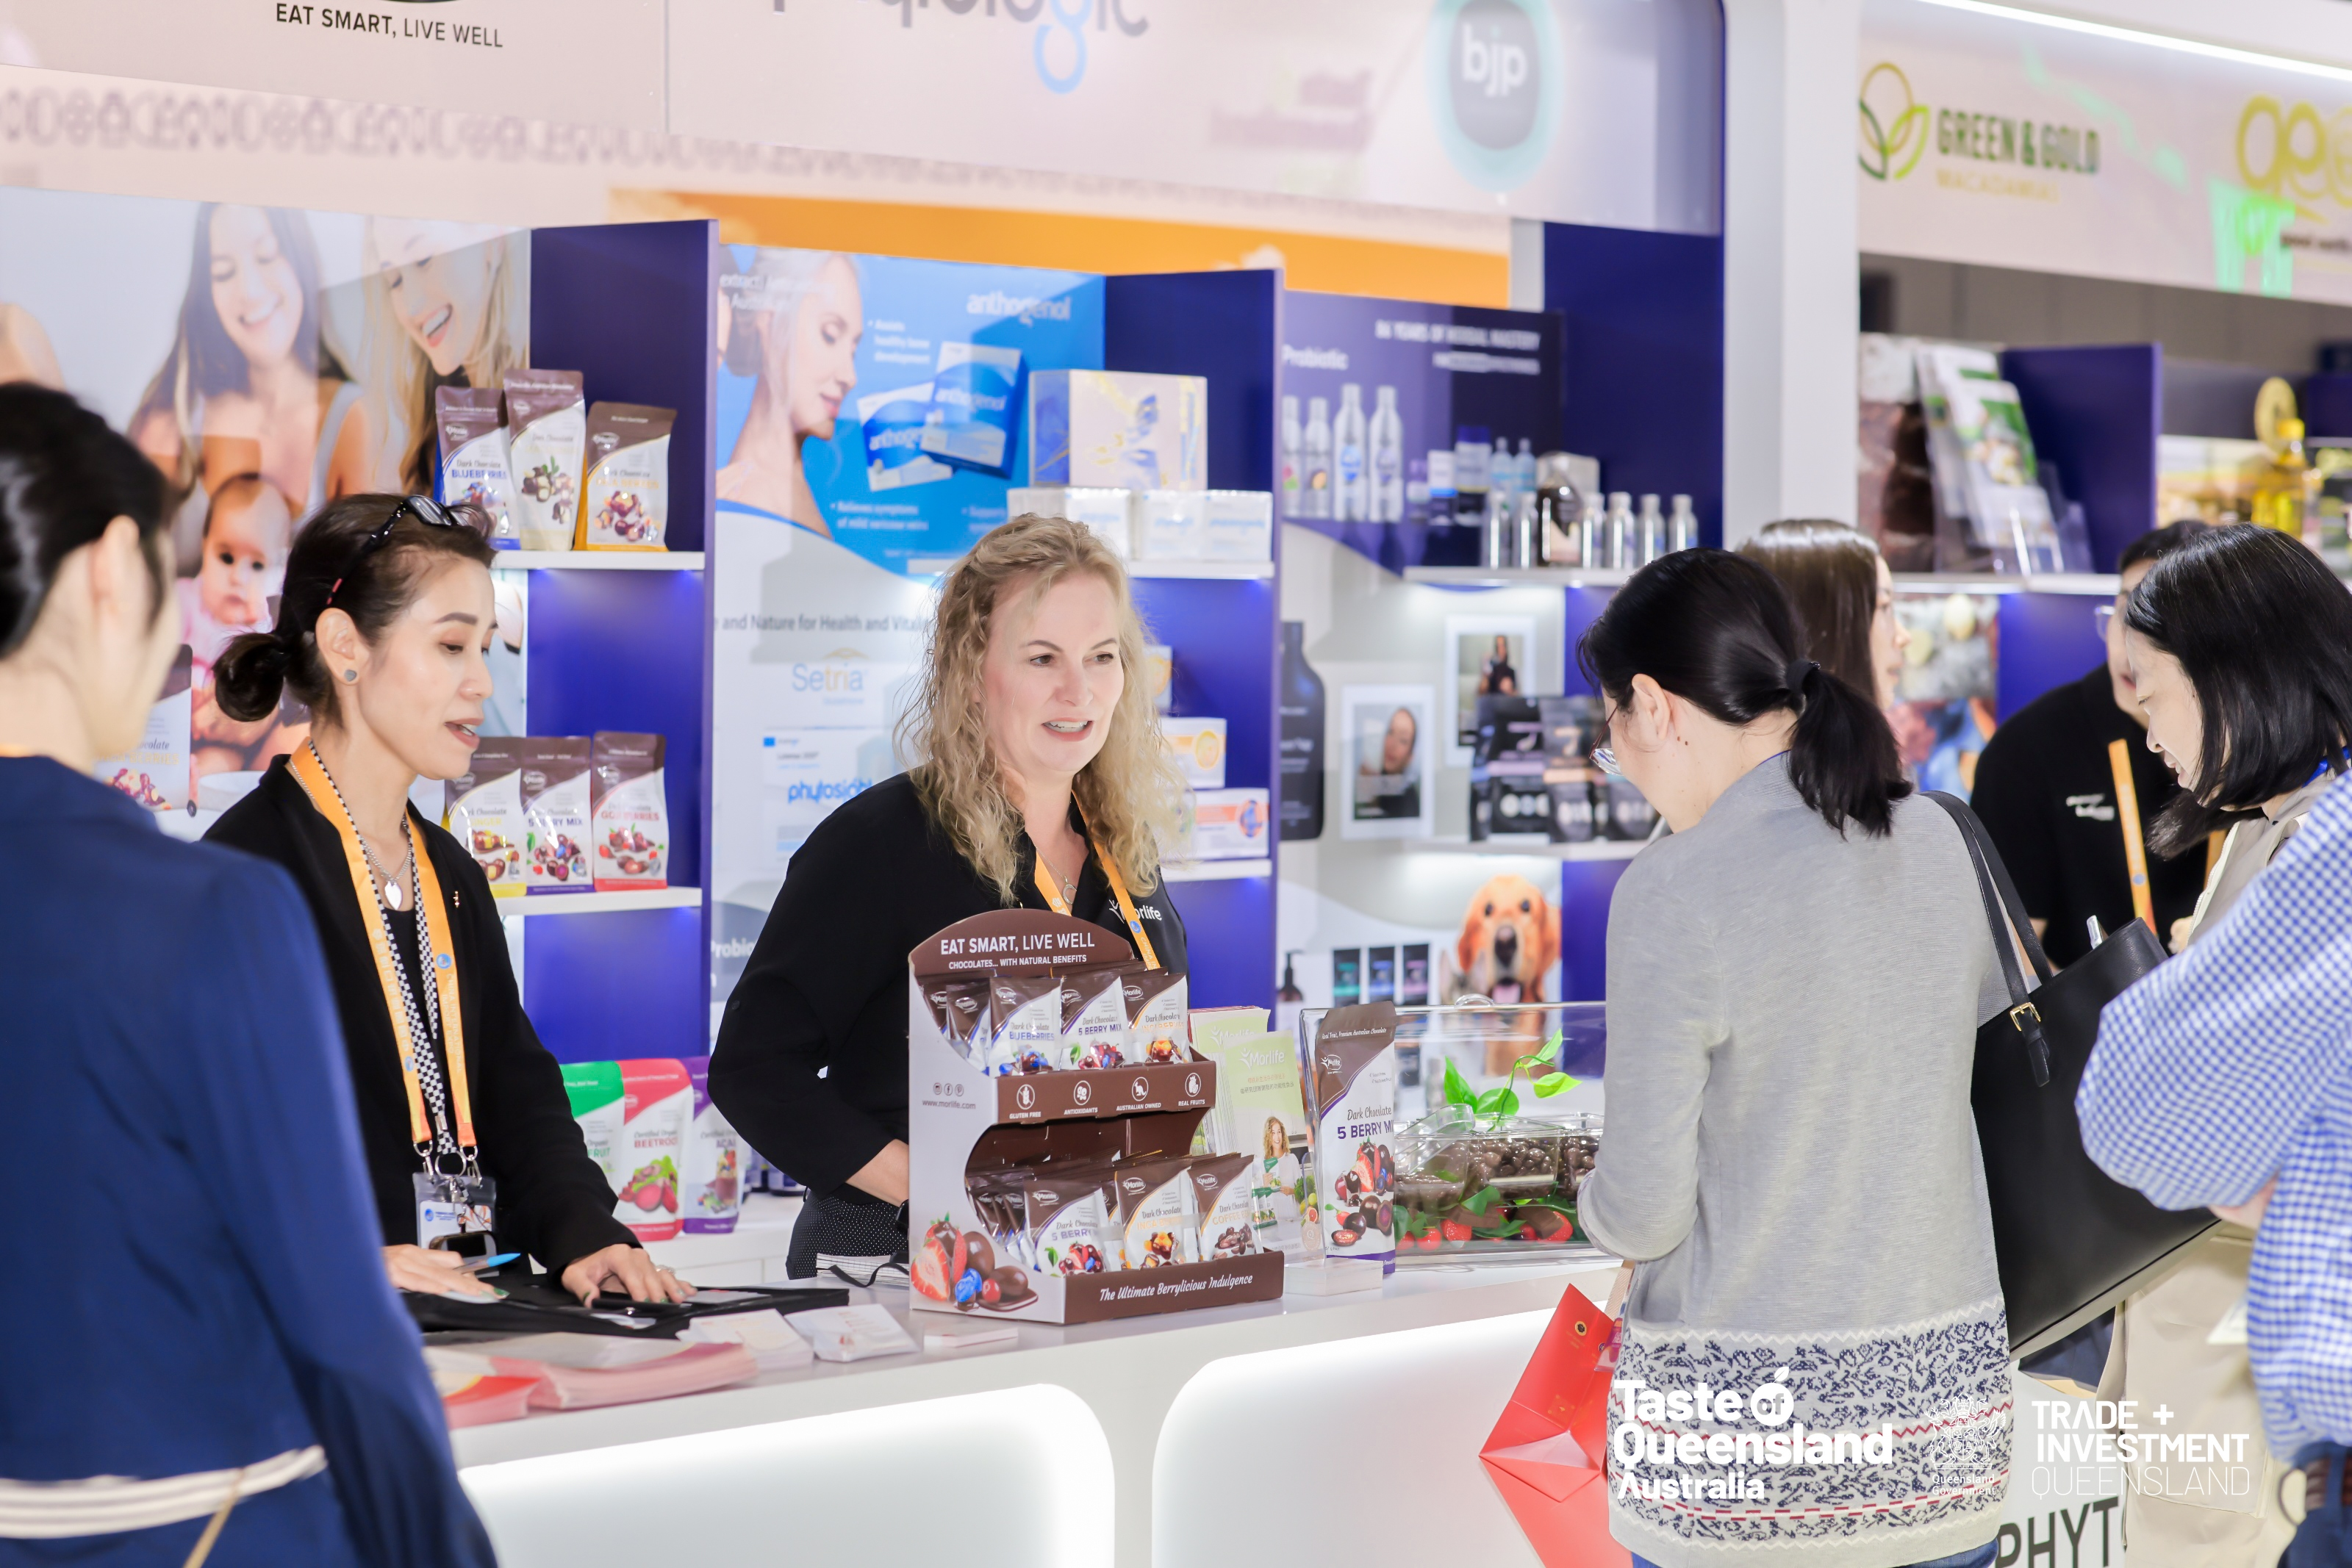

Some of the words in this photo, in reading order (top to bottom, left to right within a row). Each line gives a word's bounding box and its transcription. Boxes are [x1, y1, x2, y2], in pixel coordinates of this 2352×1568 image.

[276, 3, 314, 25] EAT
[321, 8, 397, 38] SMART,
[404, 18, 445, 41] LIVE
[453, 24, 503, 48] WELL
[1461, 22, 1530, 98] bjp
[967, 291, 1072, 324] anthogenol
[721, 616, 747, 631] and
[750, 615, 797, 632] Nature
[799, 614, 817, 632] for
[820, 615, 862, 633] Health
[865, 616, 890, 633] and
[792, 663, 864, 693] Setria
[601, 810, 621, 821] GO
[567, 818, 583, 827] MIX
[941, 939, 965, 955] EAT
[969, 935, 1019, 954] SMART,
[1022, 934, 1053, 950] LIVE
[1057, 932, 1095, 949] WELL
[1140, 937, 1152, 960] CHINA
[948, 959, 999, 970] CHOCOLATES...
[1000, 958, 1018, 967] WITH
[1019, 956, 1052, 965] NATURAL
[1053, 954, 1087, 964] BENEFITS
[446, 974, 455, 1001] CHINA
[1083, 1017, 1094, 1026] Dark
[1144, 1015, 1158, 1023] Dark
[1158, 1012, 1180, 1021] Chocola
[1078, 1027, 1083, 1036] 5
[1085, 1025, 1108, 1035] BERRY
[1109, 1023, 1122, 1032] MIX
[450, 1004, 462, 1073] INTERNATIONAL
[1009, 1032, 1055, 1041] BUEBERRIES
[1250, 1049, 1285, 1067] Morlife
[1327, 1058, 1341, 1067] Mlife
[922, 1098, 976, 1110] www.morlife.com
[1116, 1104, 1144, 1112] AUSTRALIAN
[1064, 1107, 1098, 1115] ANTIOXIDANTS
[1347, 1109, 1363, 1121] Dark
[1337, 1126, 1347, 1139] 5
[1351, 1121, 1383, 1138] BERRY
[634, 1138, 678, 1148] BEETROO
[587, 1148, 611, 1158] FRUIT
[1127, 1181, 1144, 1189] Morlife
[1201, 1177, 1216, 1185] Morlife
[1219, 1204, 1231, 1213] Dark
[1232, 1201, 1249, 1210] Chocolat
[1142, 1209, 1155, 1219] Dark
[1213, 1212, 1240, 1226] COFFEE
[1056, 1220, 1073, 1230] Dark
[1137, 1220, 1158, 1231] INCA
[1052, 1232, 1058, 1241] 5
[1100, 1287, 1114, 1301] The
[1117, 1285, 1155, 1300] Ultimate
[1157, 1279, 1208, 1297] Berrylicious
[1208, 1273, 1253, 1290] Indulgence
[1995, 1496, 2126, 1568] PHYT
